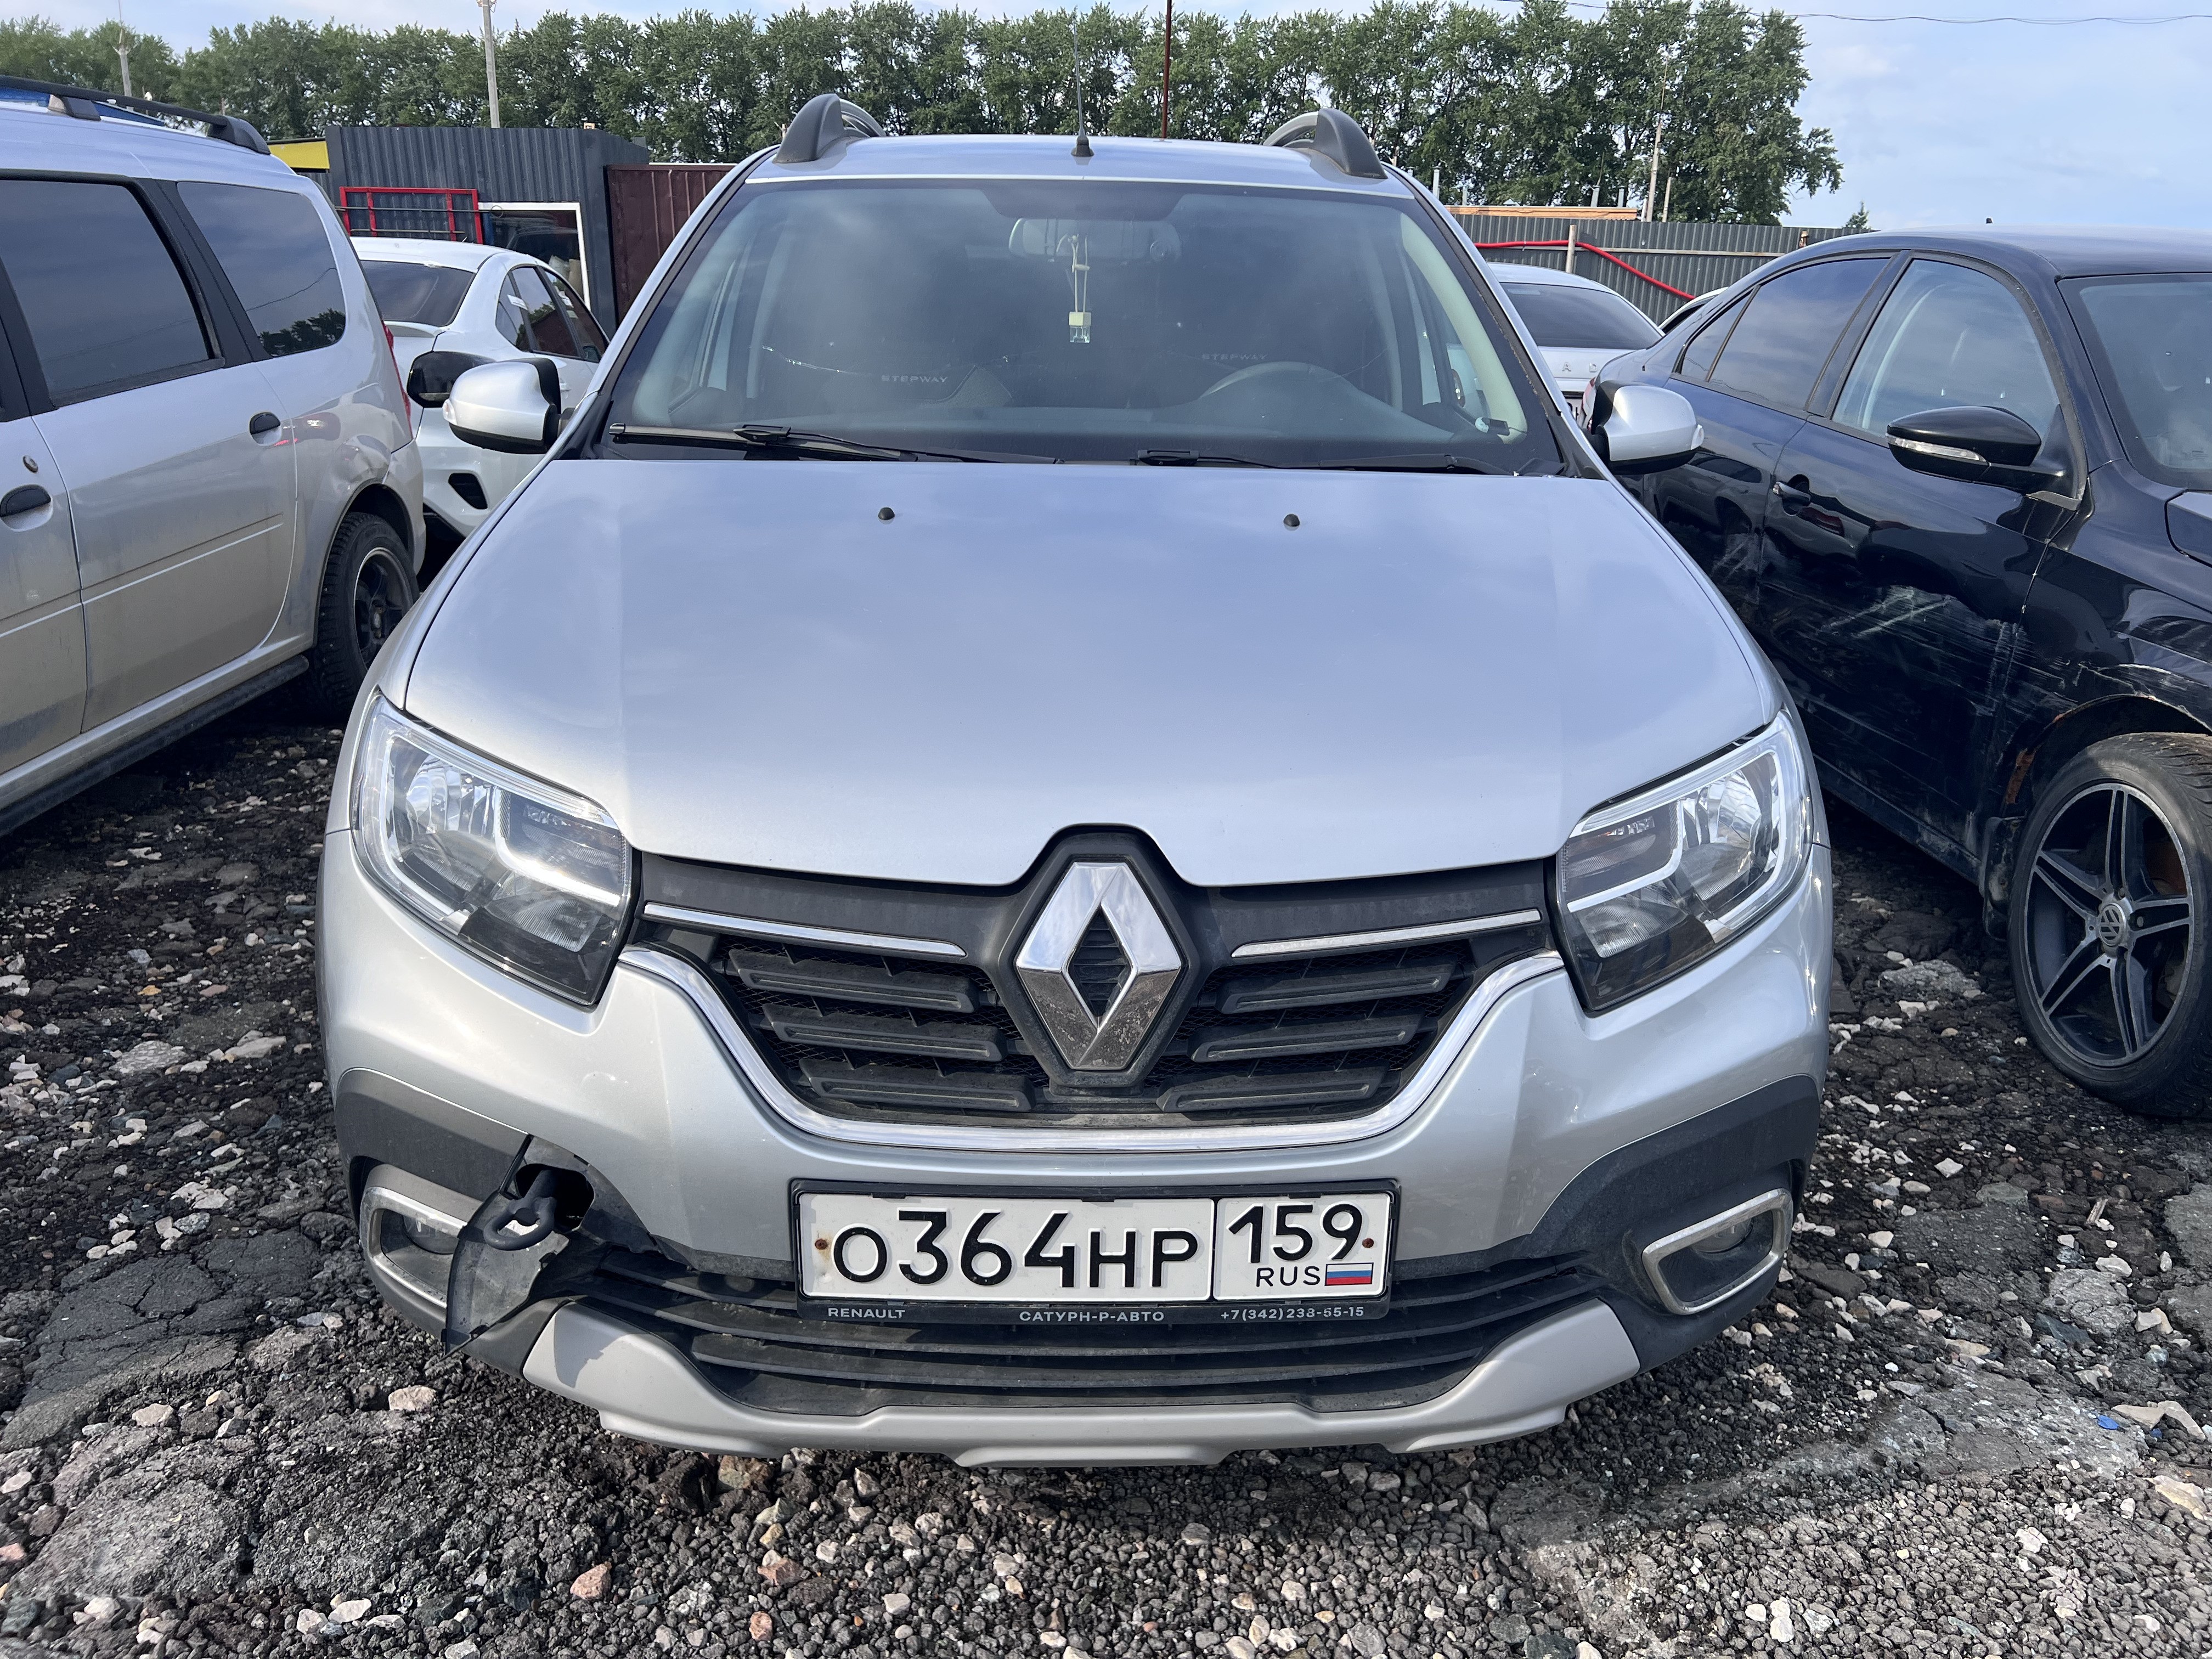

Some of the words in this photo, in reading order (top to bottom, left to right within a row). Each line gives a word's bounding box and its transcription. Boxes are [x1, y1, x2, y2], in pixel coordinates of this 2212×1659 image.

[881, 375, 949, 383] STEPWAY
[1228, 1203, 1363, 1263] 159
[1256, 1265, 1321, 1288] RUS
[827, 1307, 906, 1319] RENAULT
[1019, 1311, 1165, 1322] САТУРН-Р-АВТО
